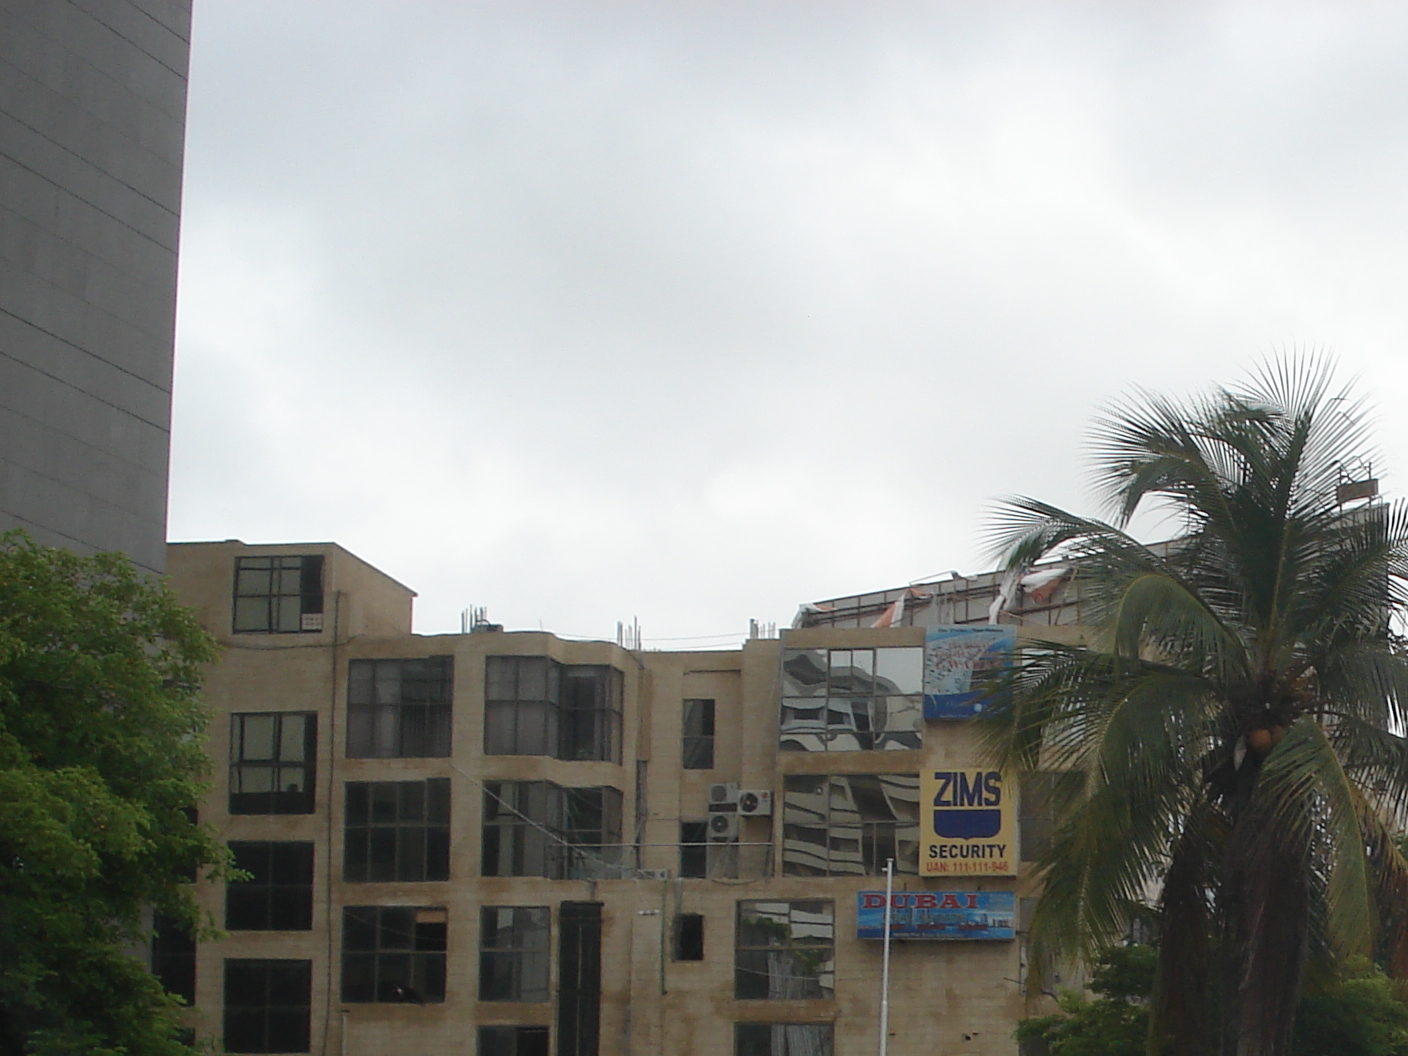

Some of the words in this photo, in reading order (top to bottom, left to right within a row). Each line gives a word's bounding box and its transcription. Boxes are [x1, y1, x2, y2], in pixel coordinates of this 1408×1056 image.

[933, 771, 1002, 807] ZIMS
[928, 844, 1006, 859] SECURITY
[862, 893, 980, 909] DUBAI
